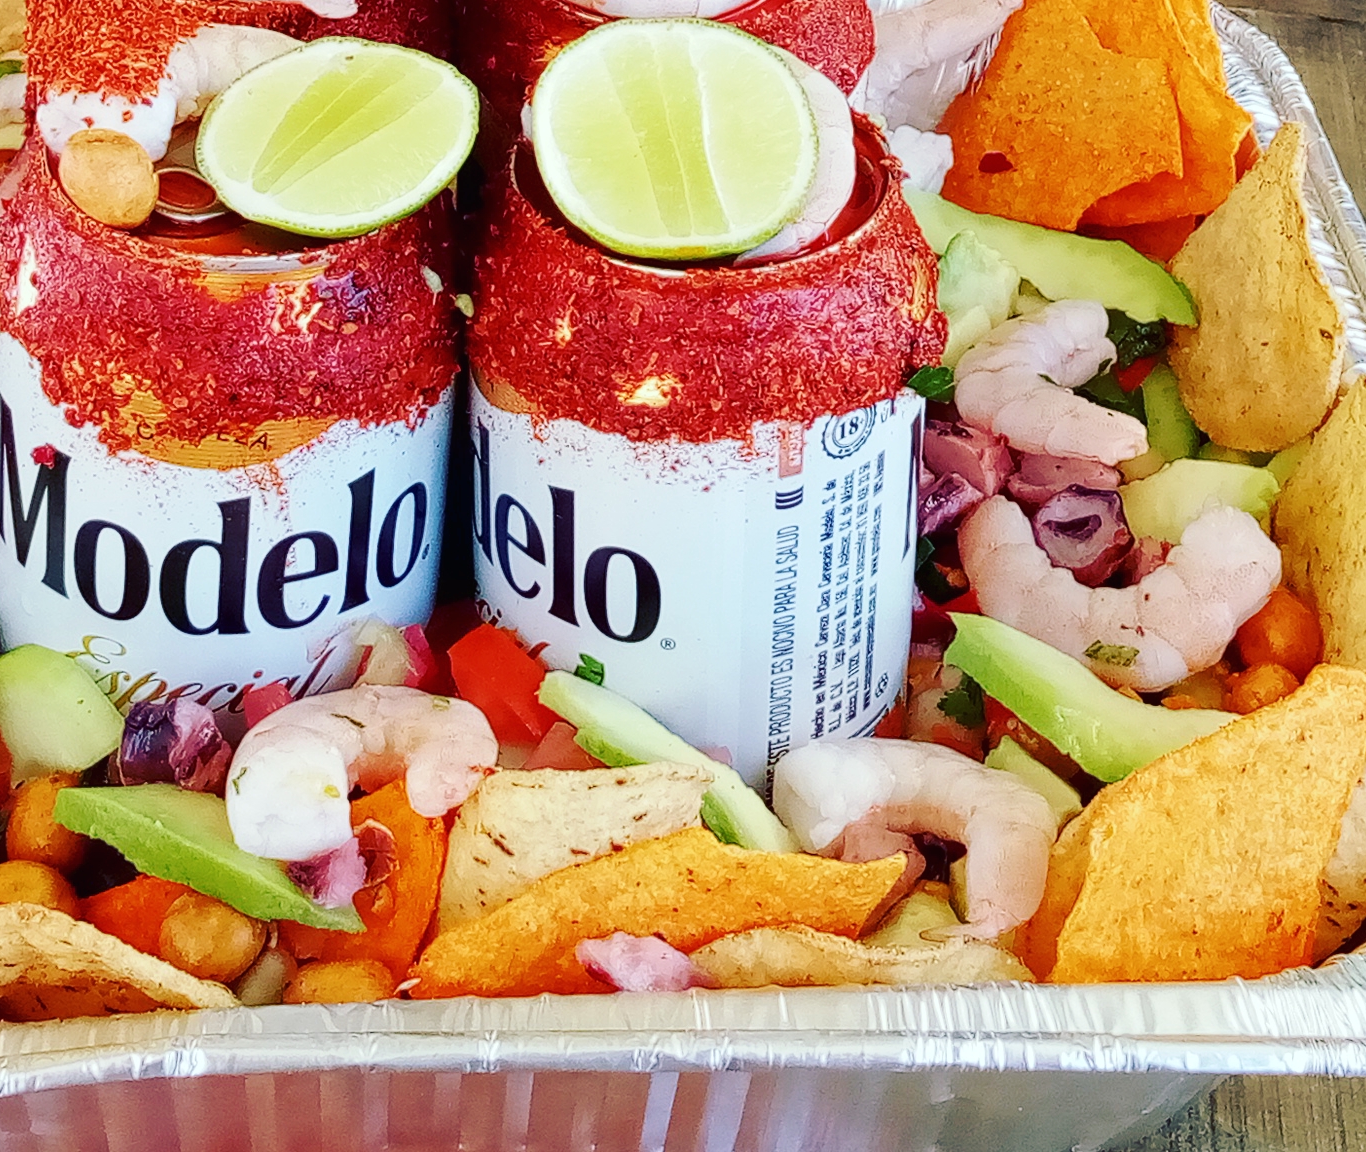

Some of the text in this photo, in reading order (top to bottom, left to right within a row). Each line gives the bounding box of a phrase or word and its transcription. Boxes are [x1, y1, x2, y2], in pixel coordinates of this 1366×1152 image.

[472, 416, 662, 643] delo
[775, 525, 799, 564] SALUD
[775, 565, 797, 582] LA
[773, 584, 797, 613] PARA
[772, 614, 795, 657] NOCIVO
[771, 659, 793, 674] ES
[769, 676, 792, 736] PRODUCTO
